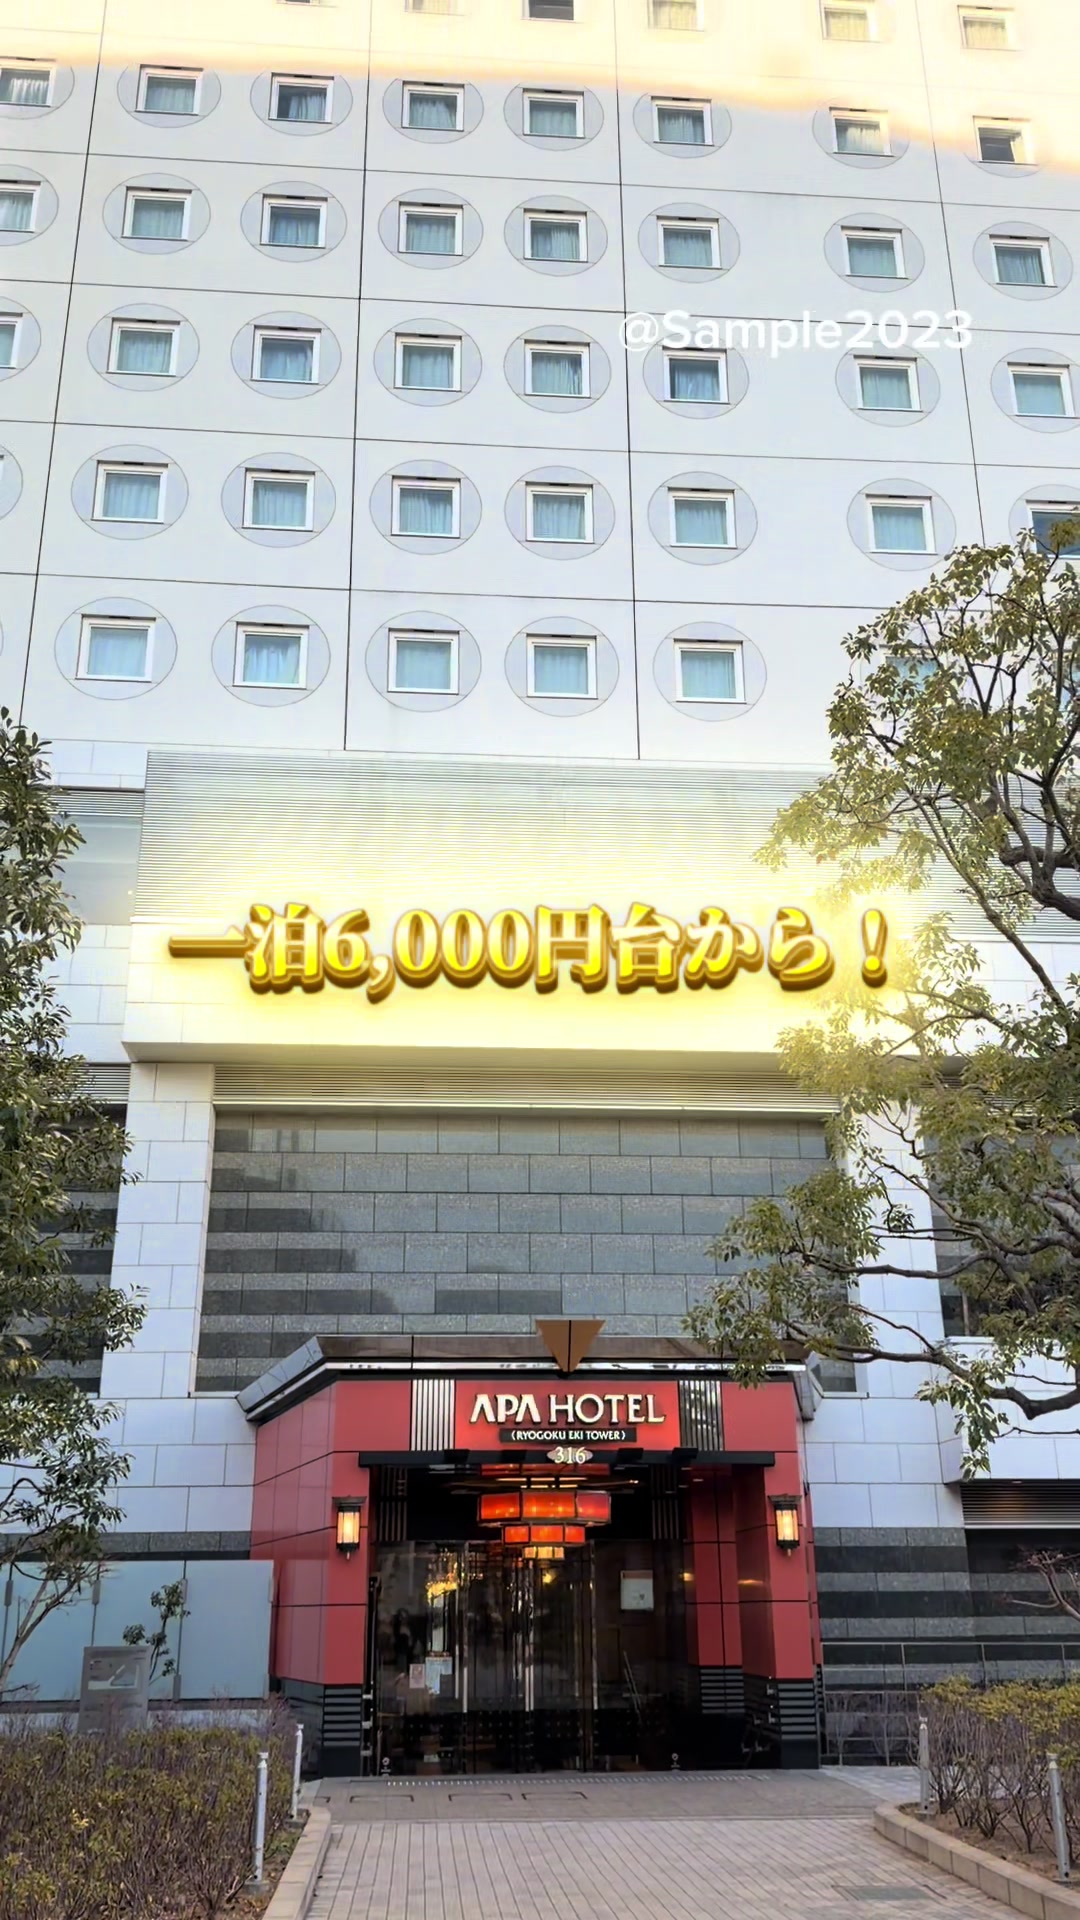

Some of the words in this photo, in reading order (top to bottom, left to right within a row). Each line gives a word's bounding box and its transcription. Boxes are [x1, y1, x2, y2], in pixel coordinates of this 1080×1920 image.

[469, 1393, 542, 1424] APA
[550, 1393, 666, 1423] HOTEL
[510, 1429, 567, 1442] (RYOGOKU
[568, 1430, 584, 1441] EKI
[586, 1430, 626, 1442] TOWER)
[554, 1446, 587, 1465] 316
